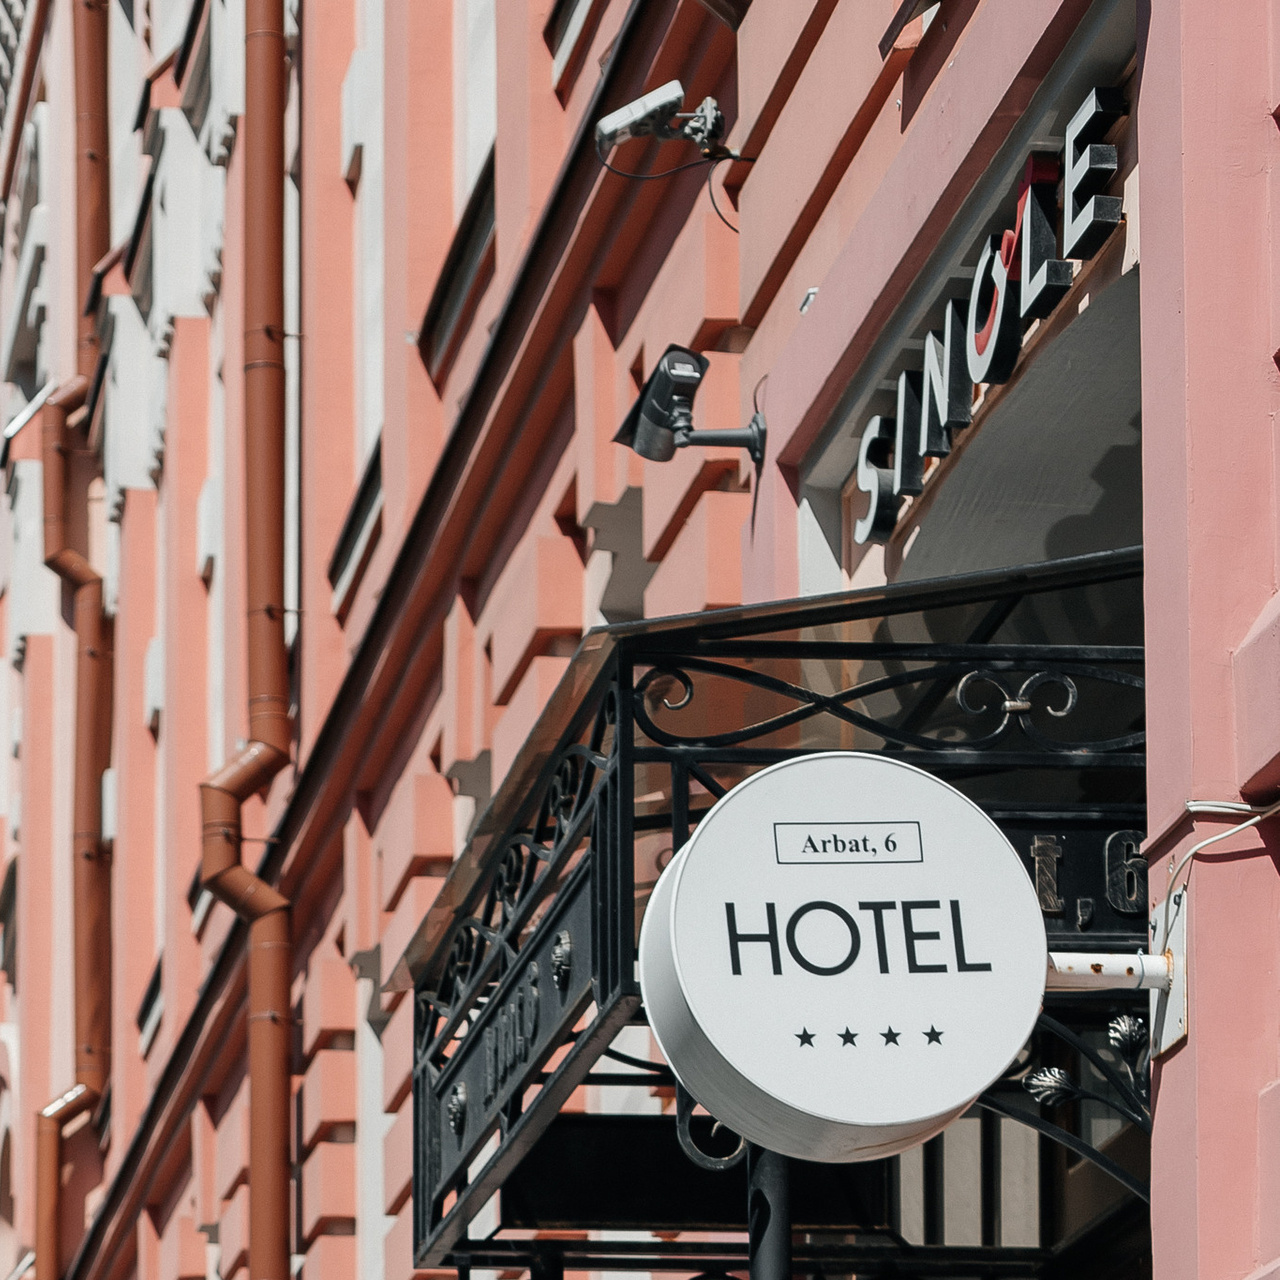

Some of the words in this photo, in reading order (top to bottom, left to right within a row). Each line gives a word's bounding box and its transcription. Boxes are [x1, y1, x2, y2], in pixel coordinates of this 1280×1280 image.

[801, 834, 877, 857] Arbat,
[884, 832, 897, 853] 6
[724, 899, 992, 976] HOTEL
